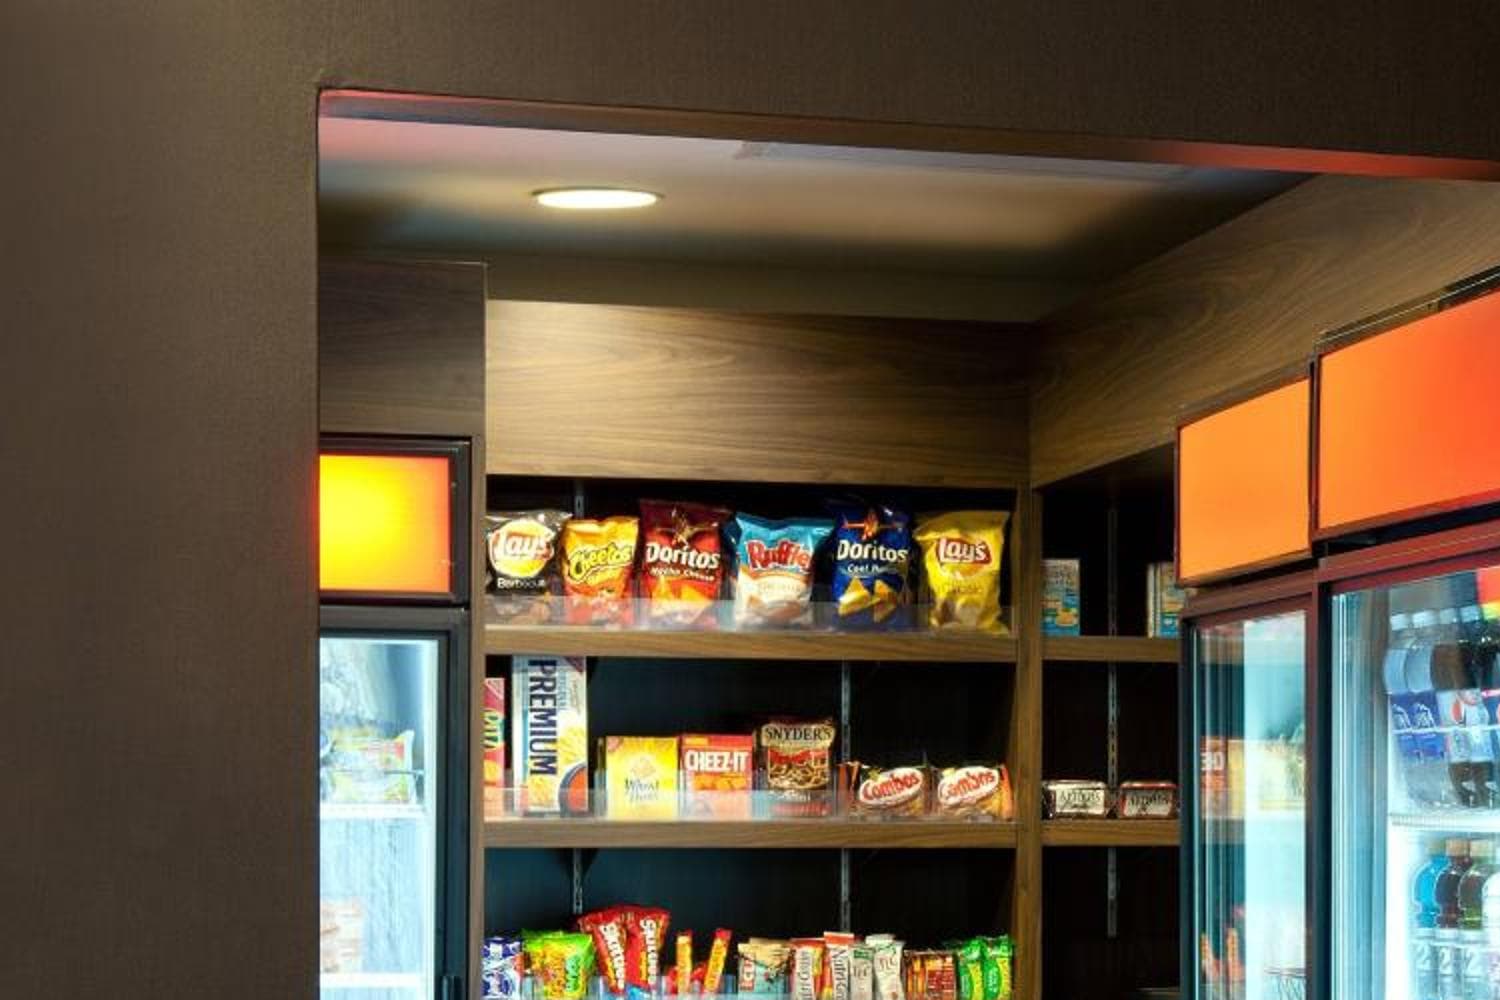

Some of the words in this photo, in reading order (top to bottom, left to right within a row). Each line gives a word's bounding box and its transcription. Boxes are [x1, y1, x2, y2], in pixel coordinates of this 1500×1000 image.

[569, 542, 633, 583] Cheetos
[646, 542, 720, 569] Doritos
[836, 539, 909, 562] Doritos
[528, 659, 558, 776] PREMIUM
[765, 726, 832, 741] SNYDER'S
[862, 770, 920, 801] Combos
[940, 770, 995, 801] Combos
